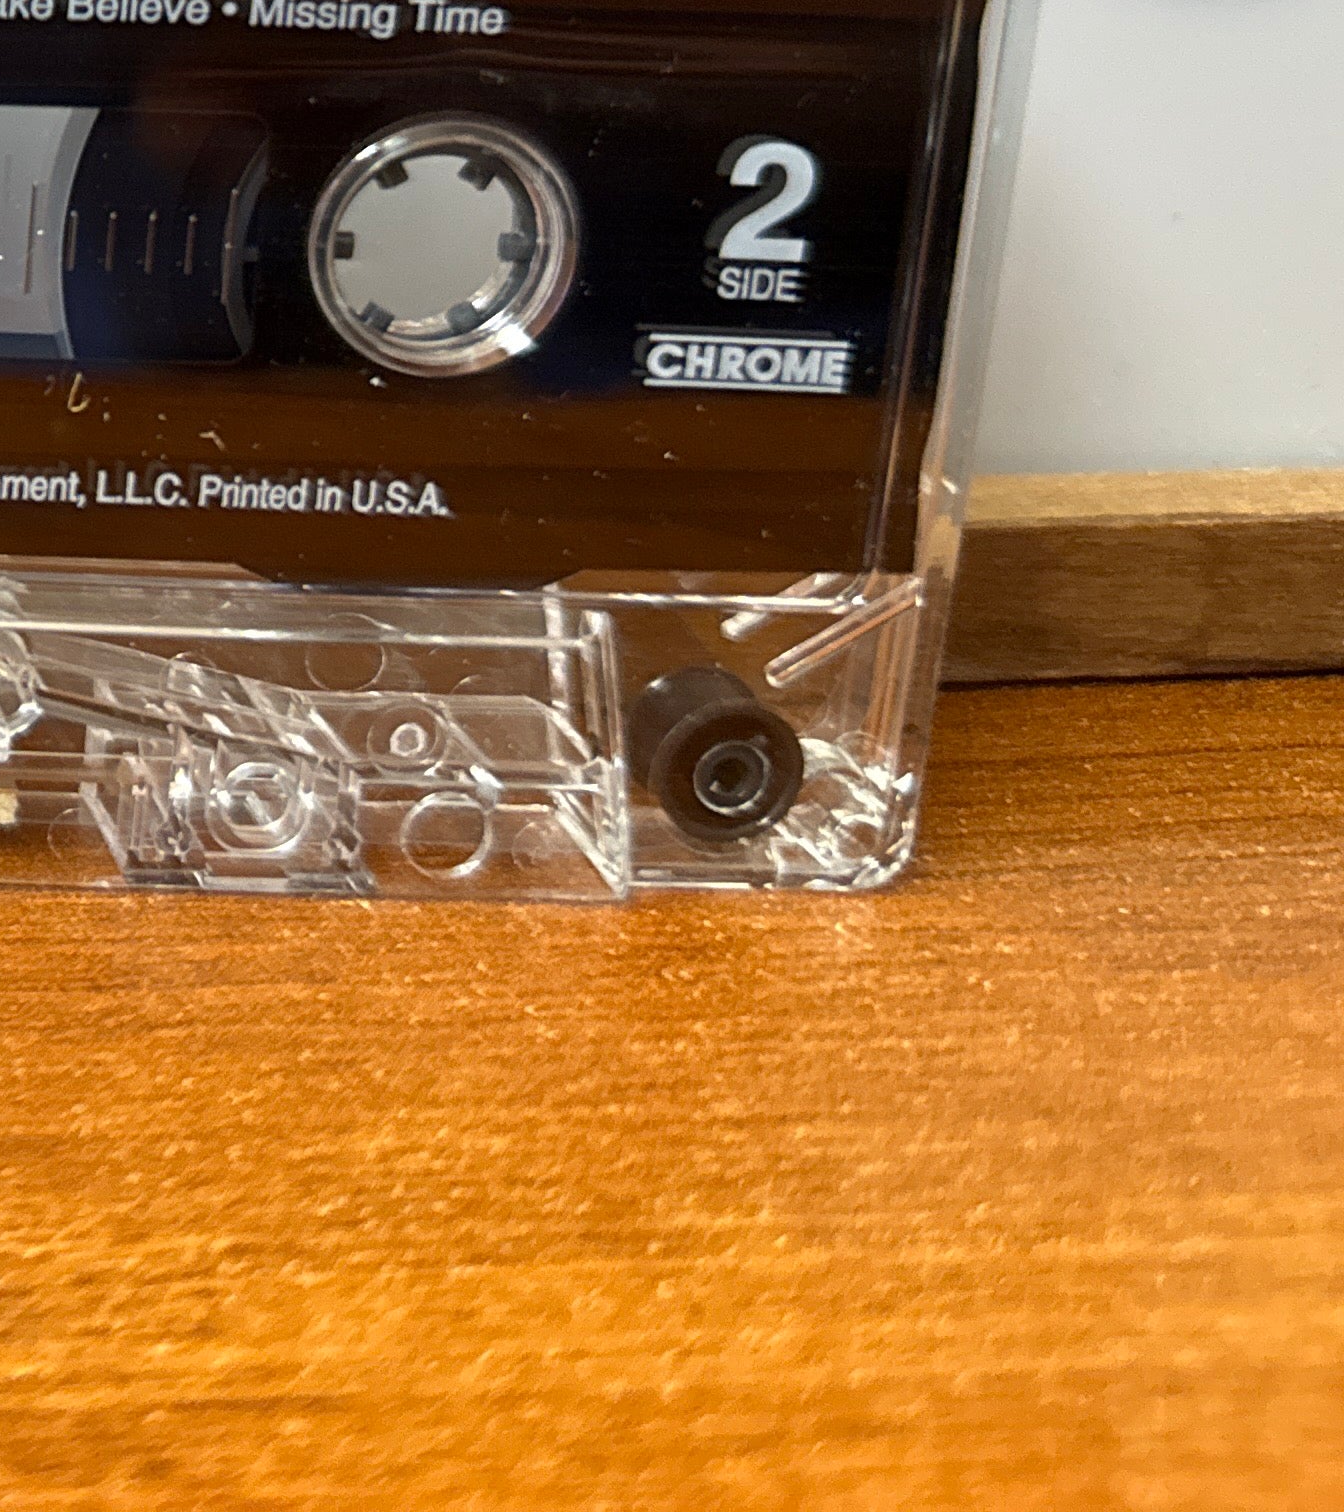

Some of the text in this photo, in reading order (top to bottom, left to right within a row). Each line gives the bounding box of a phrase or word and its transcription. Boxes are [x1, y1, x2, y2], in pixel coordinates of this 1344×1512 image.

[718, 141, 816, 262] 2
[716, 267, 806, 302] SIDE
[645, 342, 852, 386] CHROME
[96, 469, 189, 508] L.L.C.
[197, 474, 310, 511] Printed
[314, 478, 342, 512] in
[351, 478, 452, 518] U.S.A.
